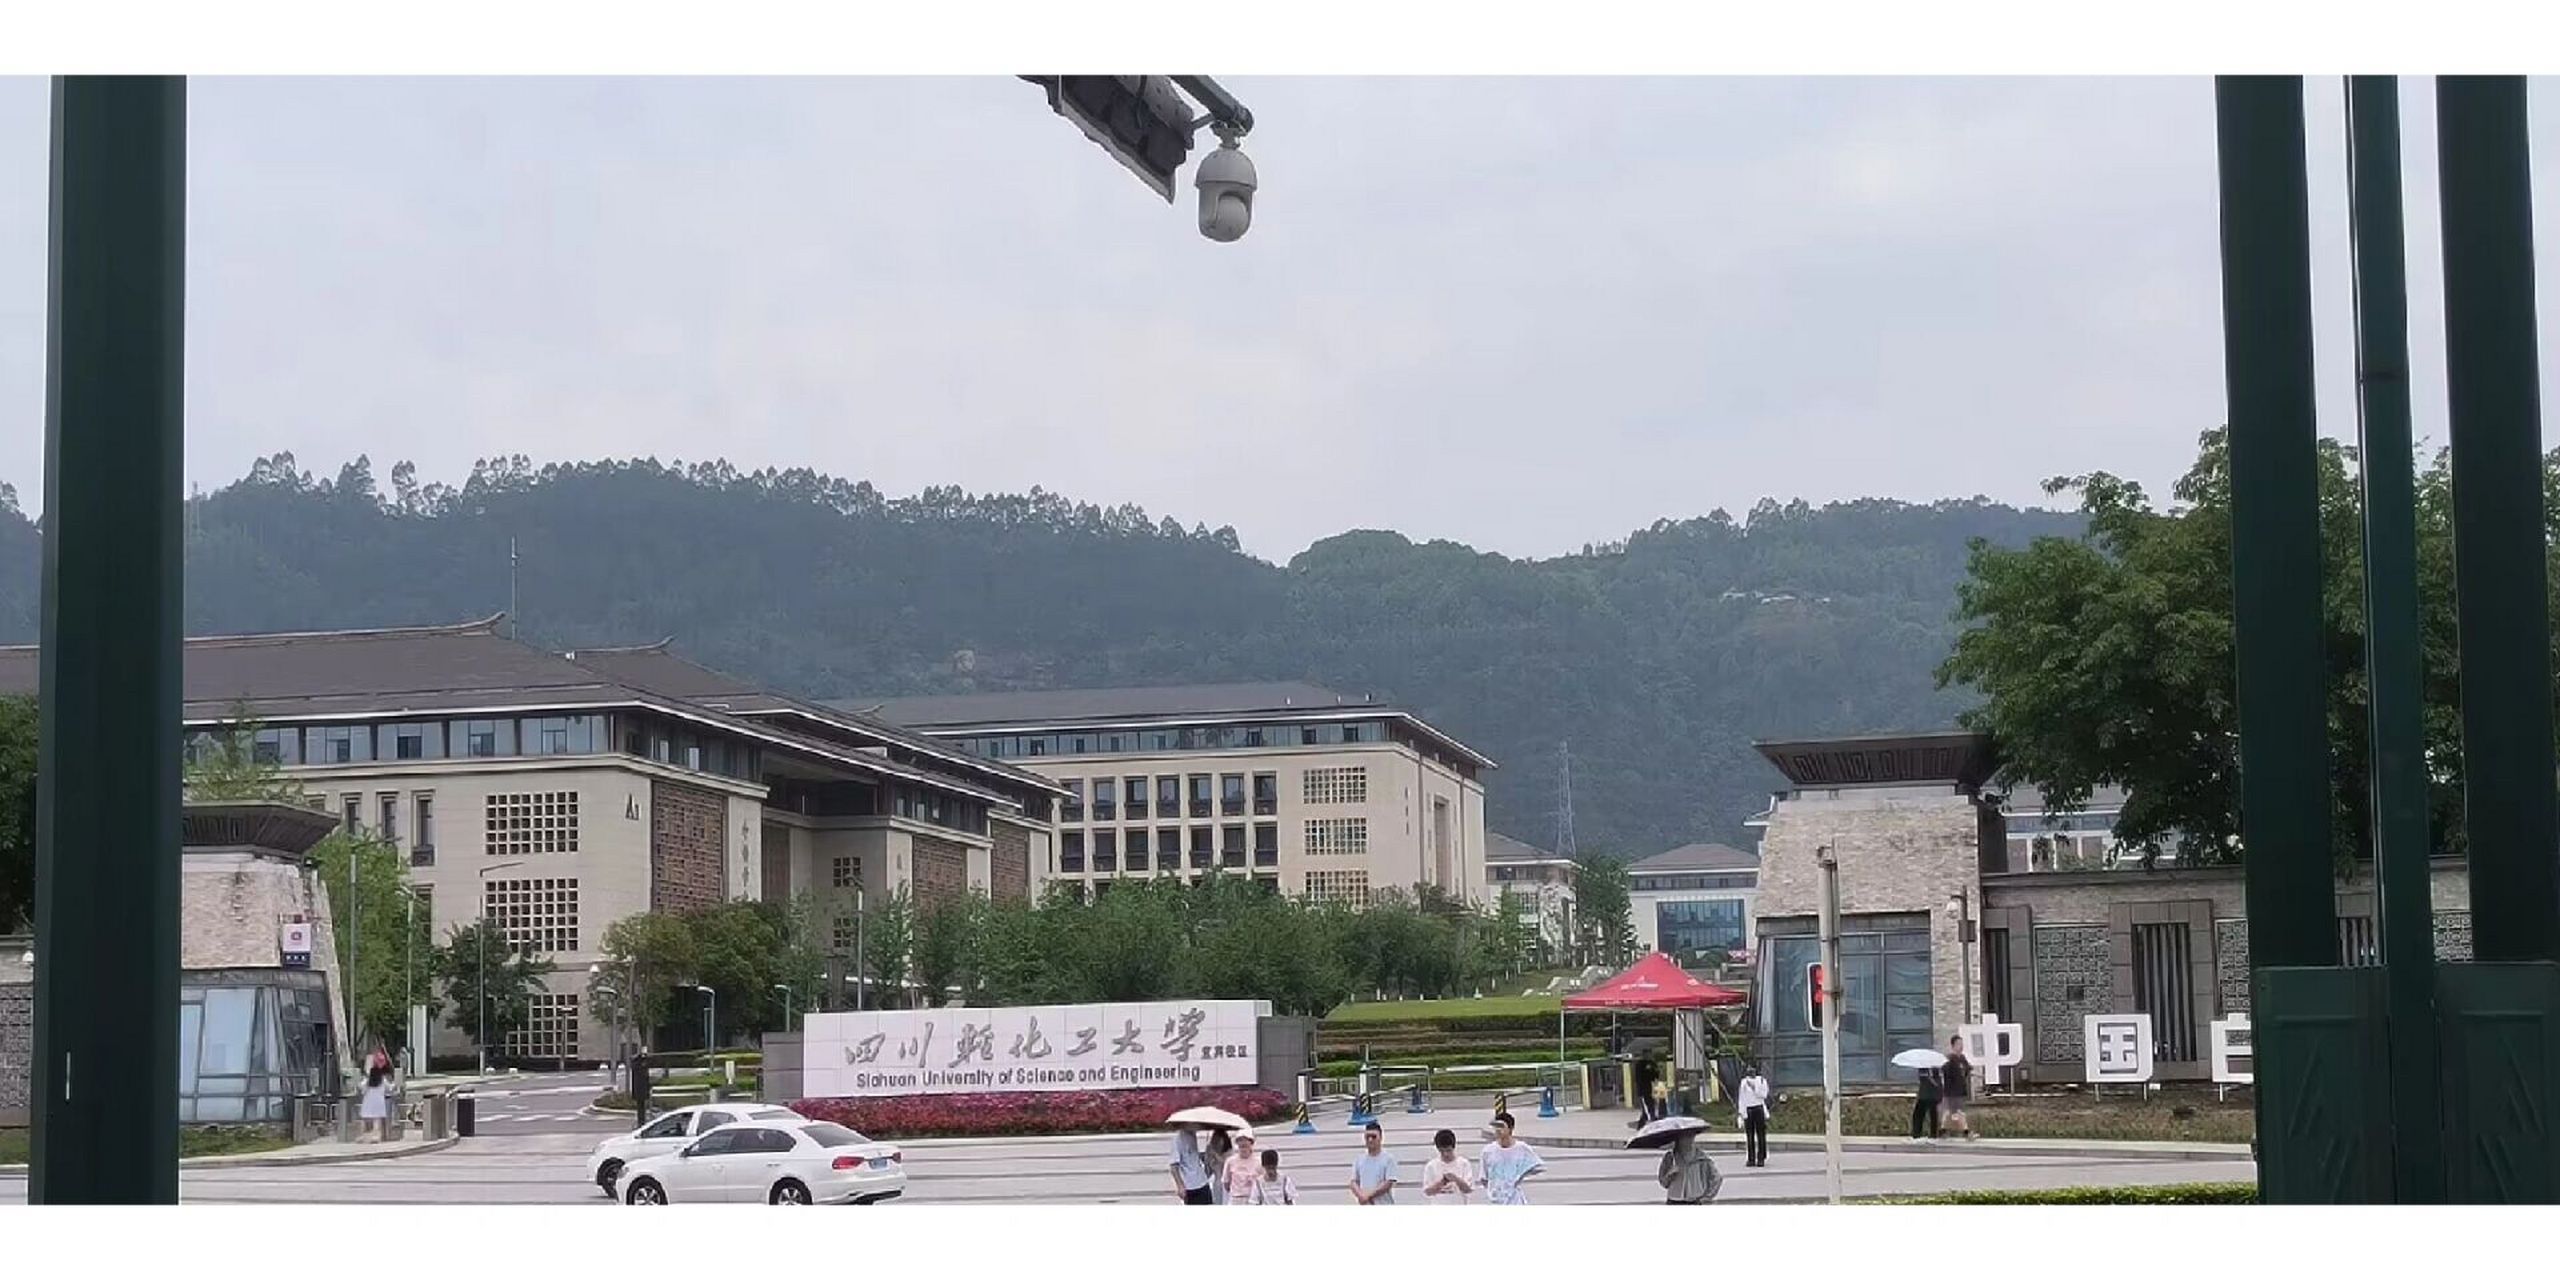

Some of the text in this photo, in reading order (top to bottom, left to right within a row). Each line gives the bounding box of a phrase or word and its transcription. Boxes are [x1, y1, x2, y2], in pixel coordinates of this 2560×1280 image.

[922, 1069, 994, 1087] University
[999, 1068, 1012, 1083] of
[1016, 1066, 1074, 1084] Science
[1078, 1064, 1105, 1082] and
[1110, 1064, 1201, 1084] Engineering
